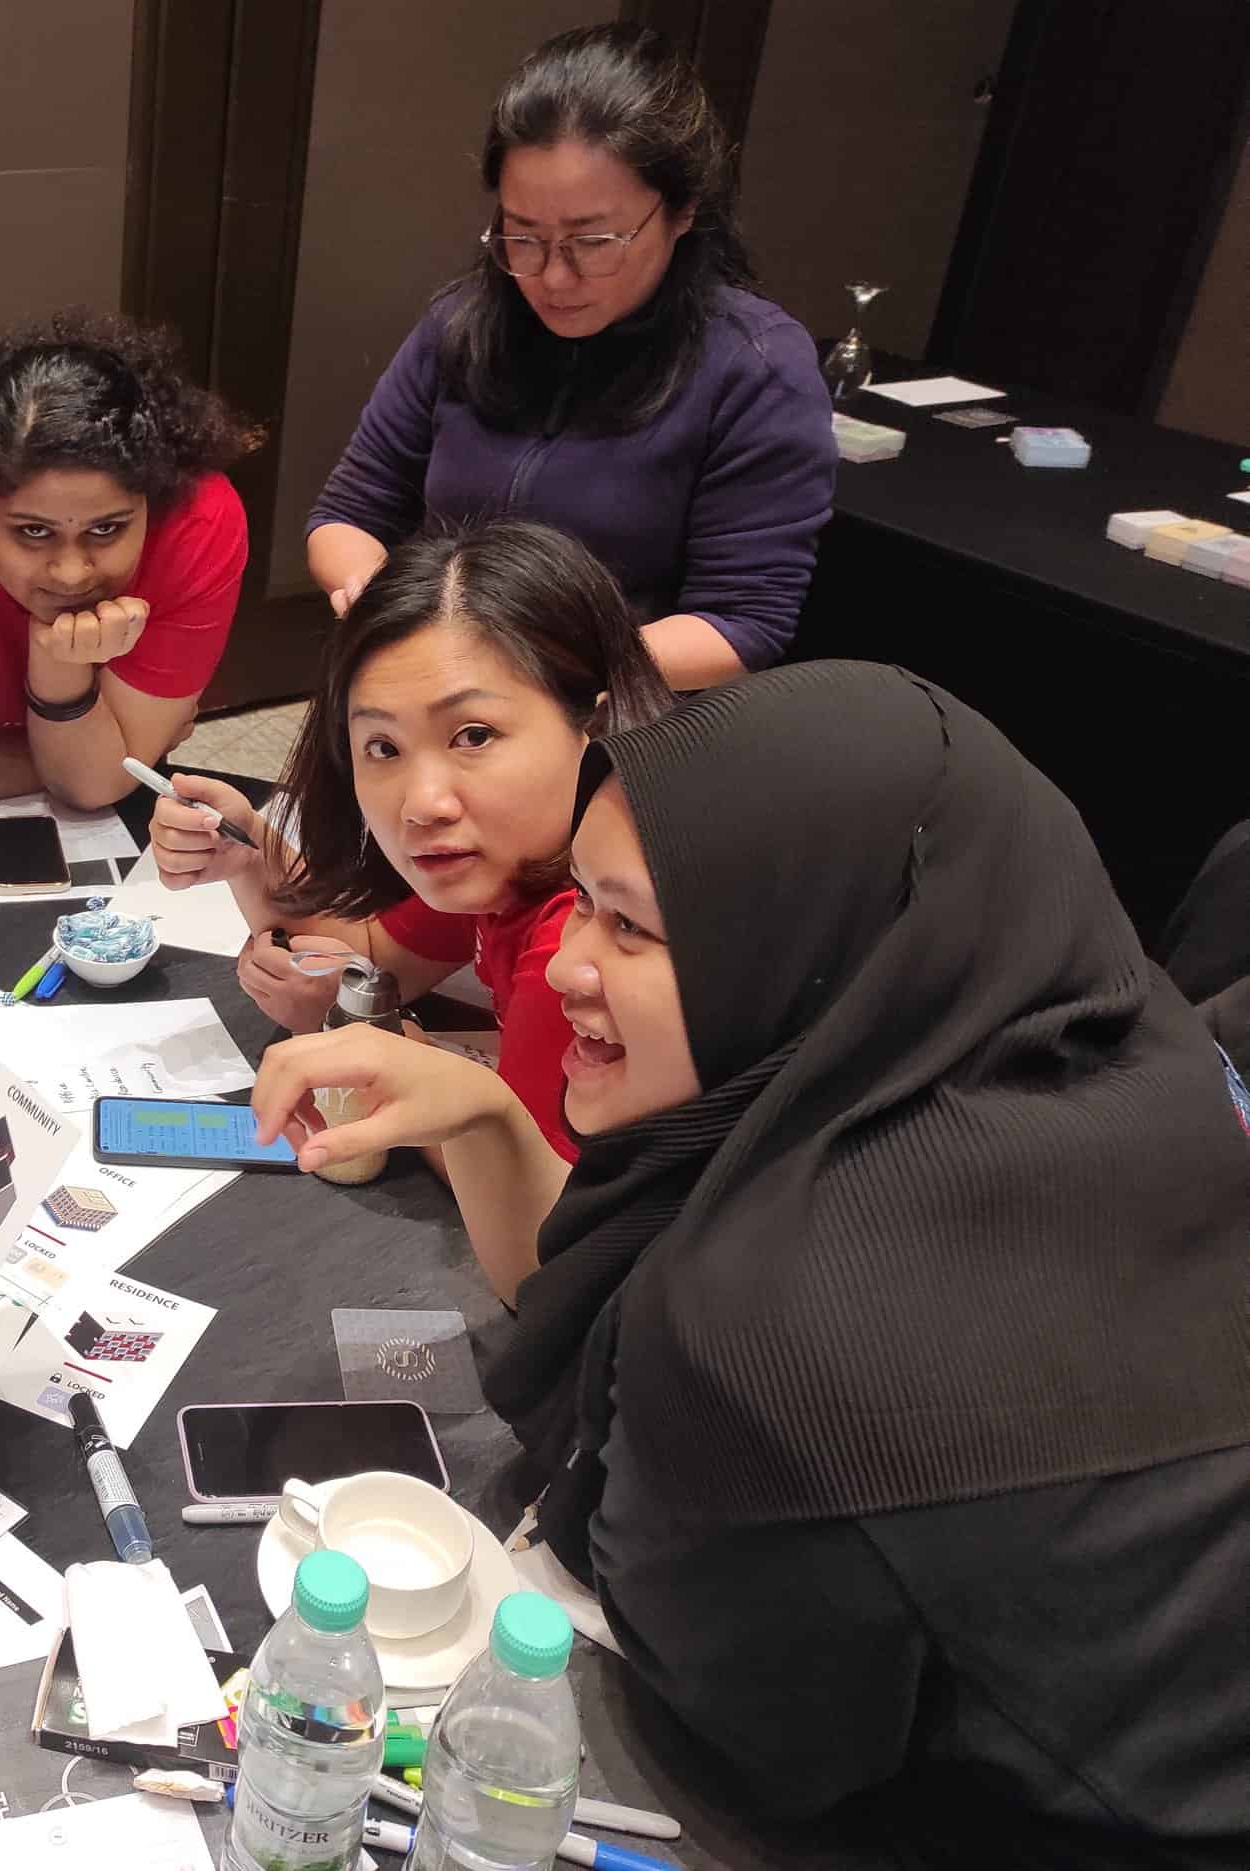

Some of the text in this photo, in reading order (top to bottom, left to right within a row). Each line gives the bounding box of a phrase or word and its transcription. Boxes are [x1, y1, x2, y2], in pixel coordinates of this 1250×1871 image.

[6, 1084, 62, 1136] COMMUNITY
[98, 1166, 138, 1189] OFFICE
[24, 1240, 57, 1260] LOCKED
[109, 1278, 182, 1312] RESIDENCE
[66, 1380, 106, 1401] LOCKED
